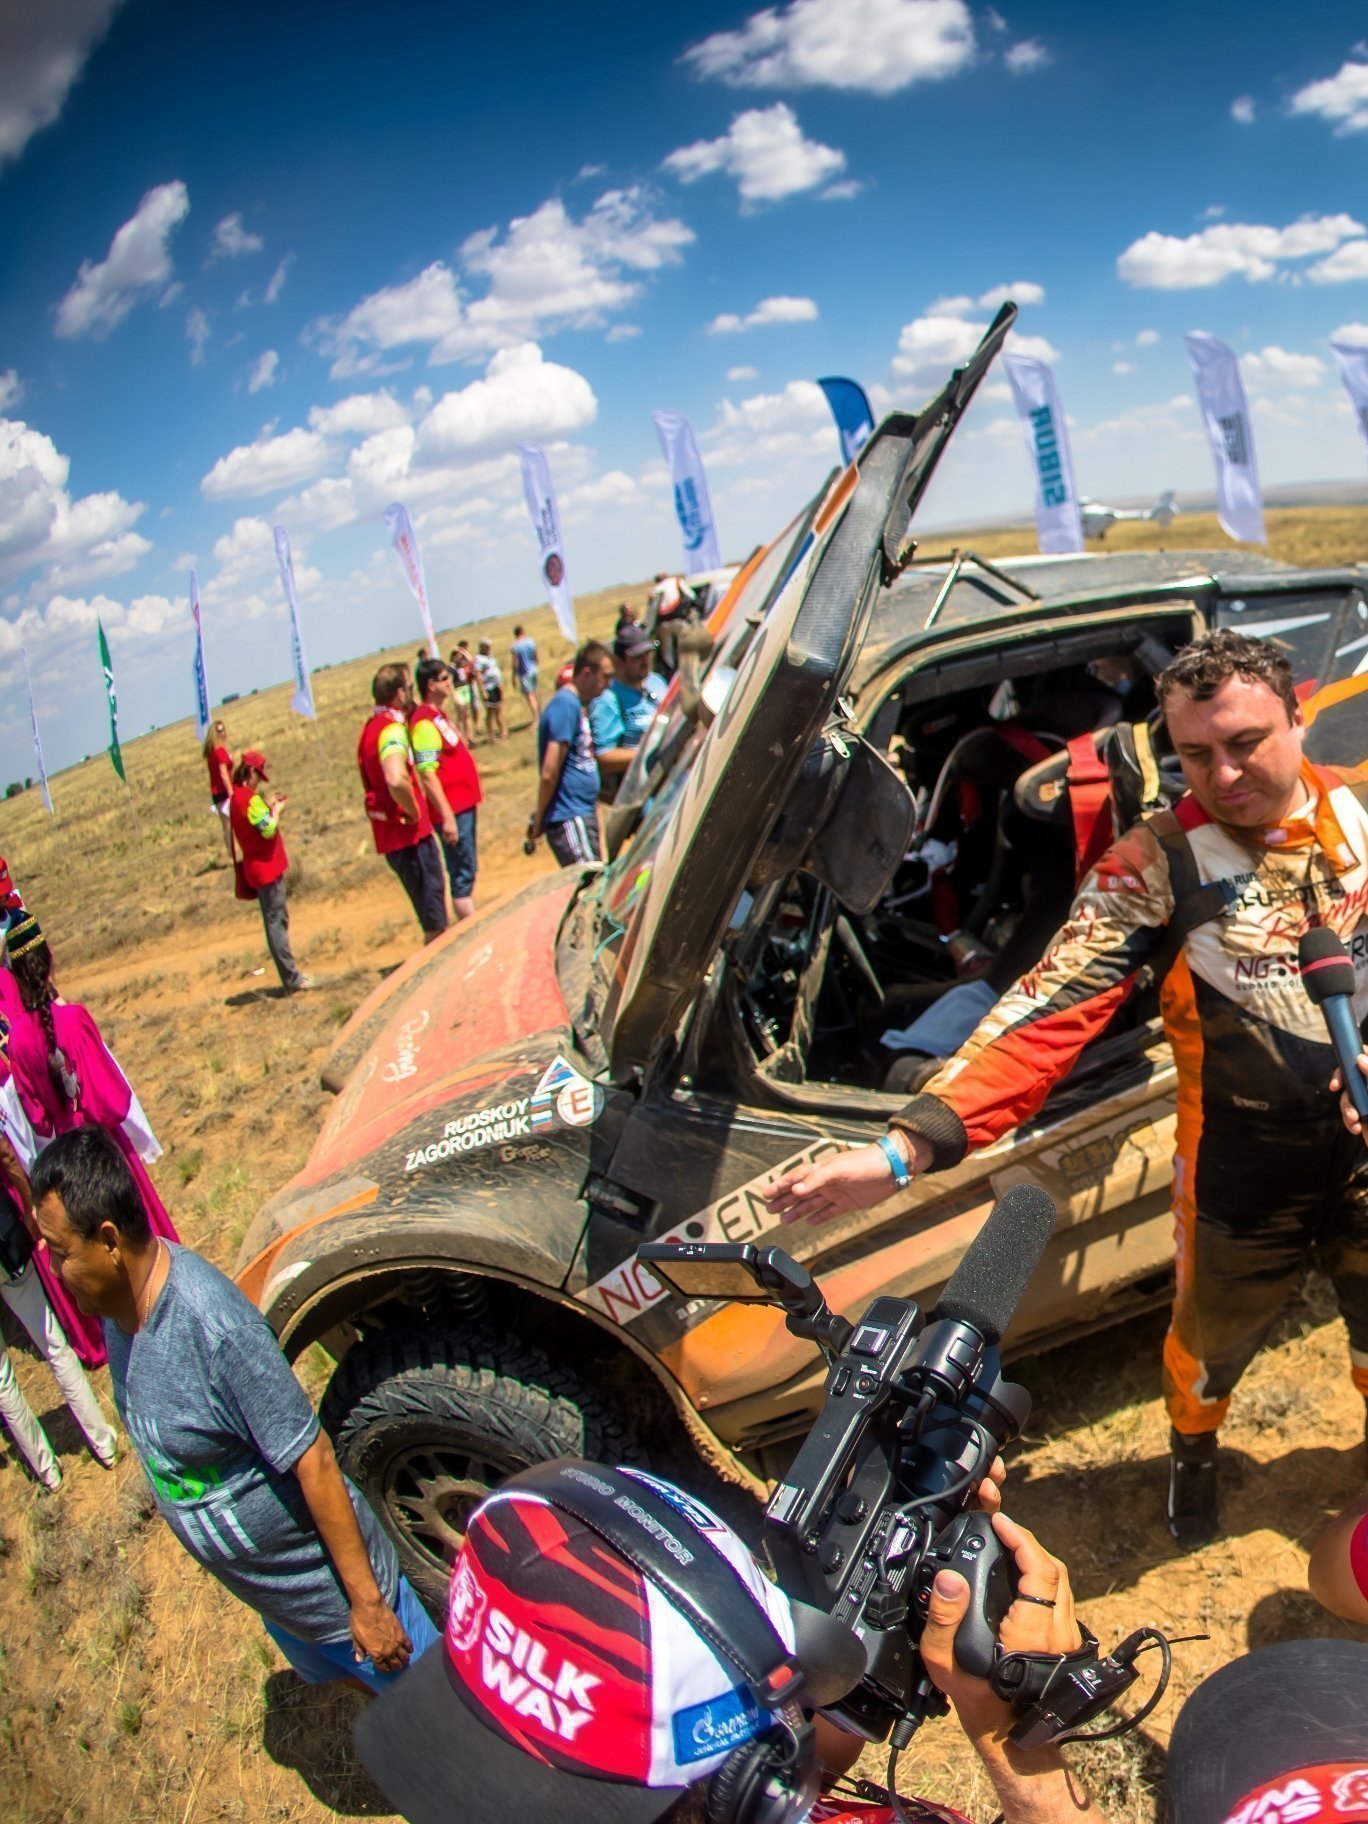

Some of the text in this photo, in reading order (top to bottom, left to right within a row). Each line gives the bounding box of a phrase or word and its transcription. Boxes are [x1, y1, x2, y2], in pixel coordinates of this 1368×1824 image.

[405, 1116, 531, 1171] ZAGORODNIUK
[444, 1098, 529, 1138] RUDSKOY
[613, 1495, 695, 1567] MONITOR
[481, 1639, 596, 1741] WAY
[485, 1607, 603, 1713] SILK
